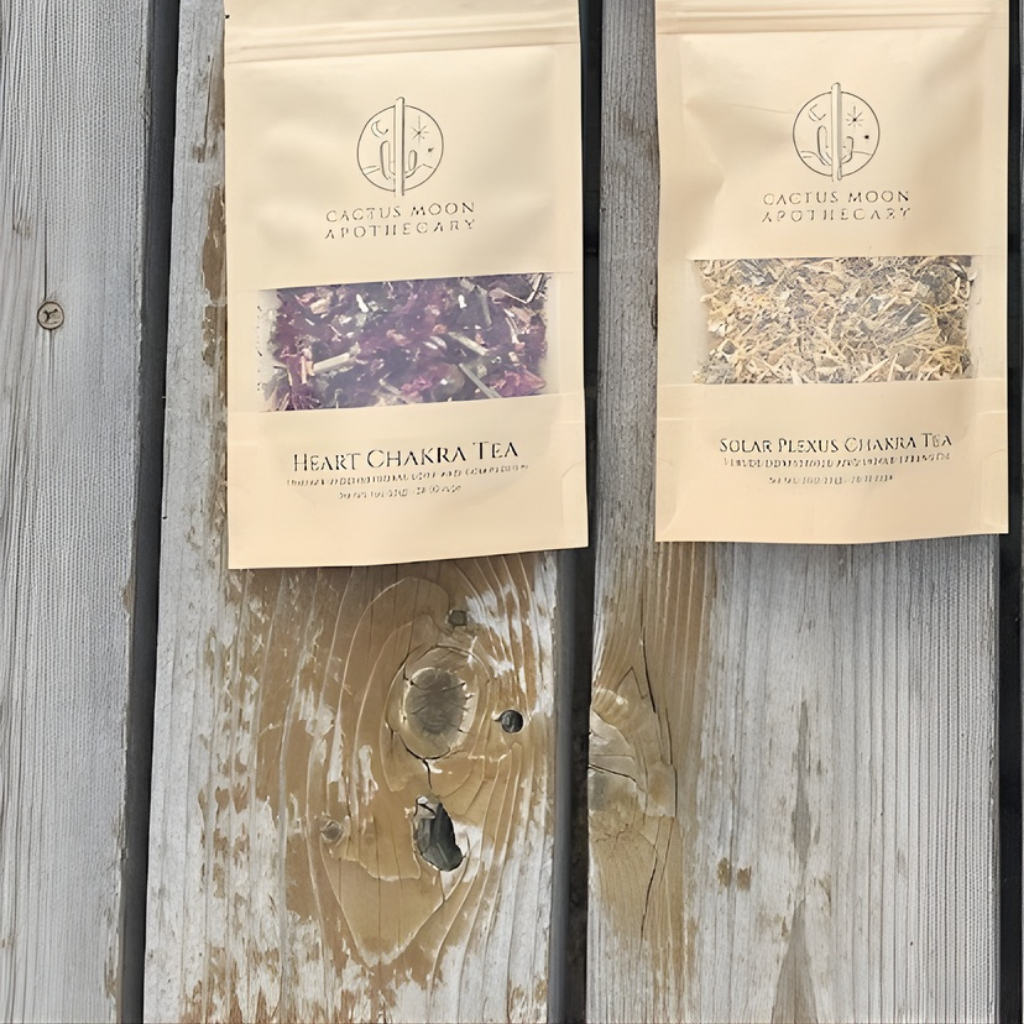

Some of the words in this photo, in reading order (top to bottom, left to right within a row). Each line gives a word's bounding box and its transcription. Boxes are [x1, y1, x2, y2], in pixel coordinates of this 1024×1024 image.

[763, 191, 838, 205] CACTUS
[848, 190, 908, 203] MOON
[326, 205, 401, 222] CACTUS
[411, 202, 474, 217] MOON
[720, 438, 772, 453] SOLAR
[778, 438, 838, 453] PLEXUS
[844, 436, 916, 453] CHAKRA
[922, 433, 952, 447] TEA
[293, 452, 361, 471] HEART
[367, 446, 466, 468] CHAKRA
[472, 441, 518, 459] TEA
